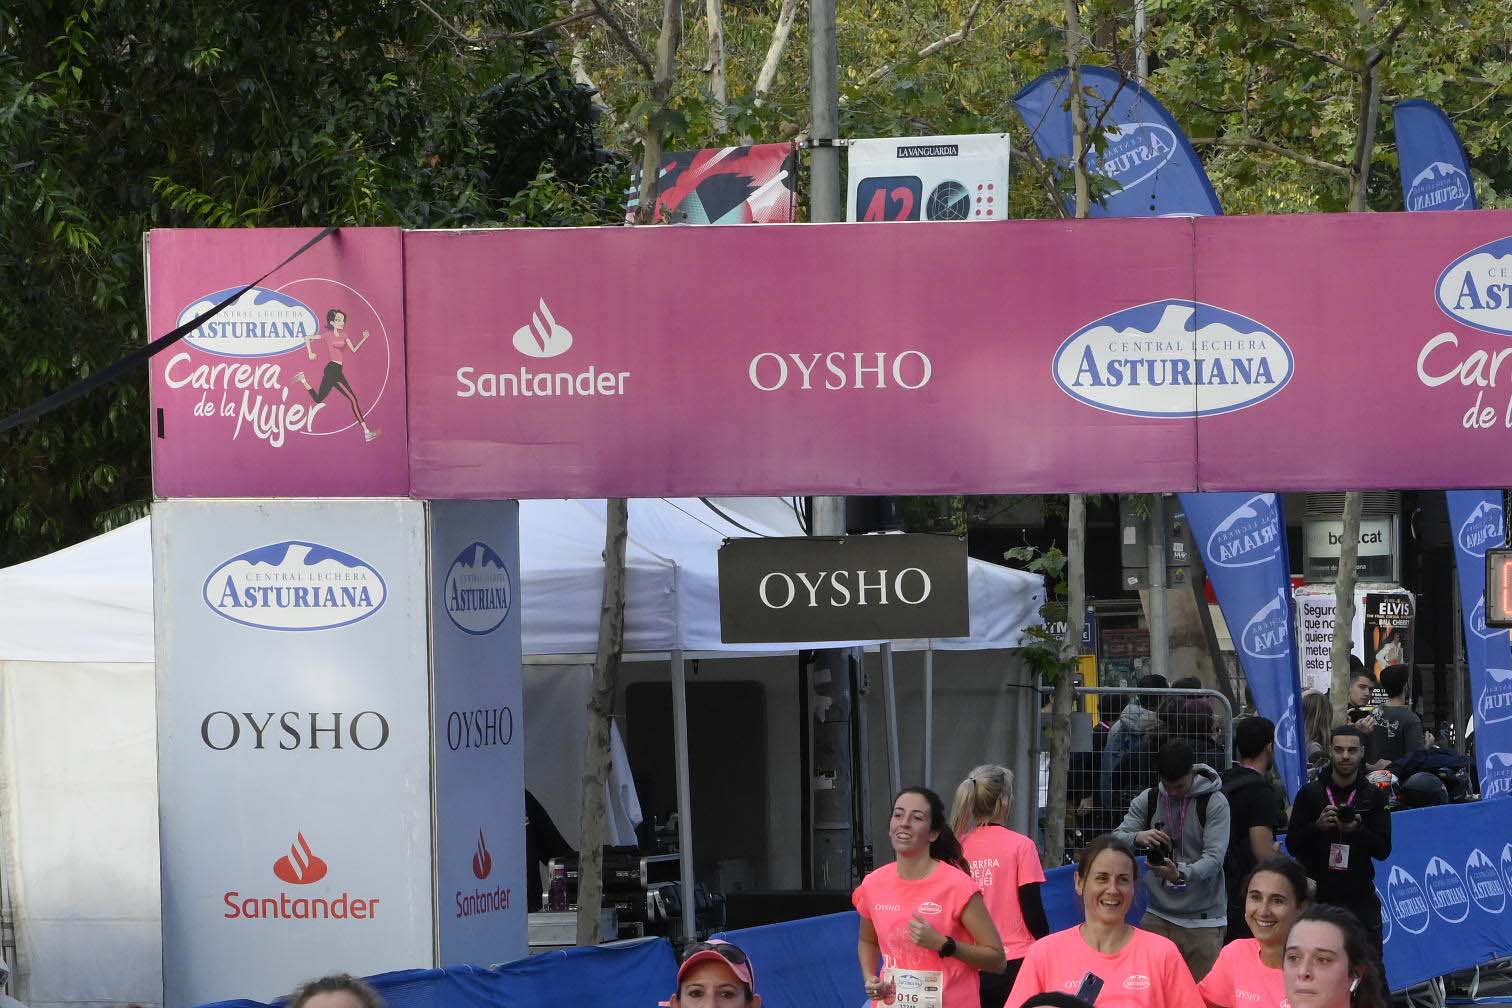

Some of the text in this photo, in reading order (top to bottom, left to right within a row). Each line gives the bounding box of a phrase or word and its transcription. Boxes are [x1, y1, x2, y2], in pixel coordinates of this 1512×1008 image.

[1109, 341, 1266, 352] CENTRAL LECHERA
[165, 353, 281, 389] Carrera
[457, 365, 630, 397] Santander
[749, 350, 932, 391] OYSHO
[1072, 345, 1275, 387] ASTURIANA
[194, 387, 326, 447] de la Mujer
[1463, 391, 1496, 429] de
[218, 575, 373, 608] ASTURIANA
[245, 572, 367, 582] CENTRAL LECHERA
[759, 567, 931, 609] OYSHO
[450, 578, 507, 611] ASTURIANA
[1379, 603, 1410, 615] ELVIS
[1305, 620, 1320, 631] que
[1306, 659, 1324, 669] este
[201, 711, 390, 751] OYSHO
[447, 707, 512, 751] OYSHO
[224, 892, 379, 919] Santander
[456, 887, 511, 918] Santander
[898, 994, 918, 1002] 016
